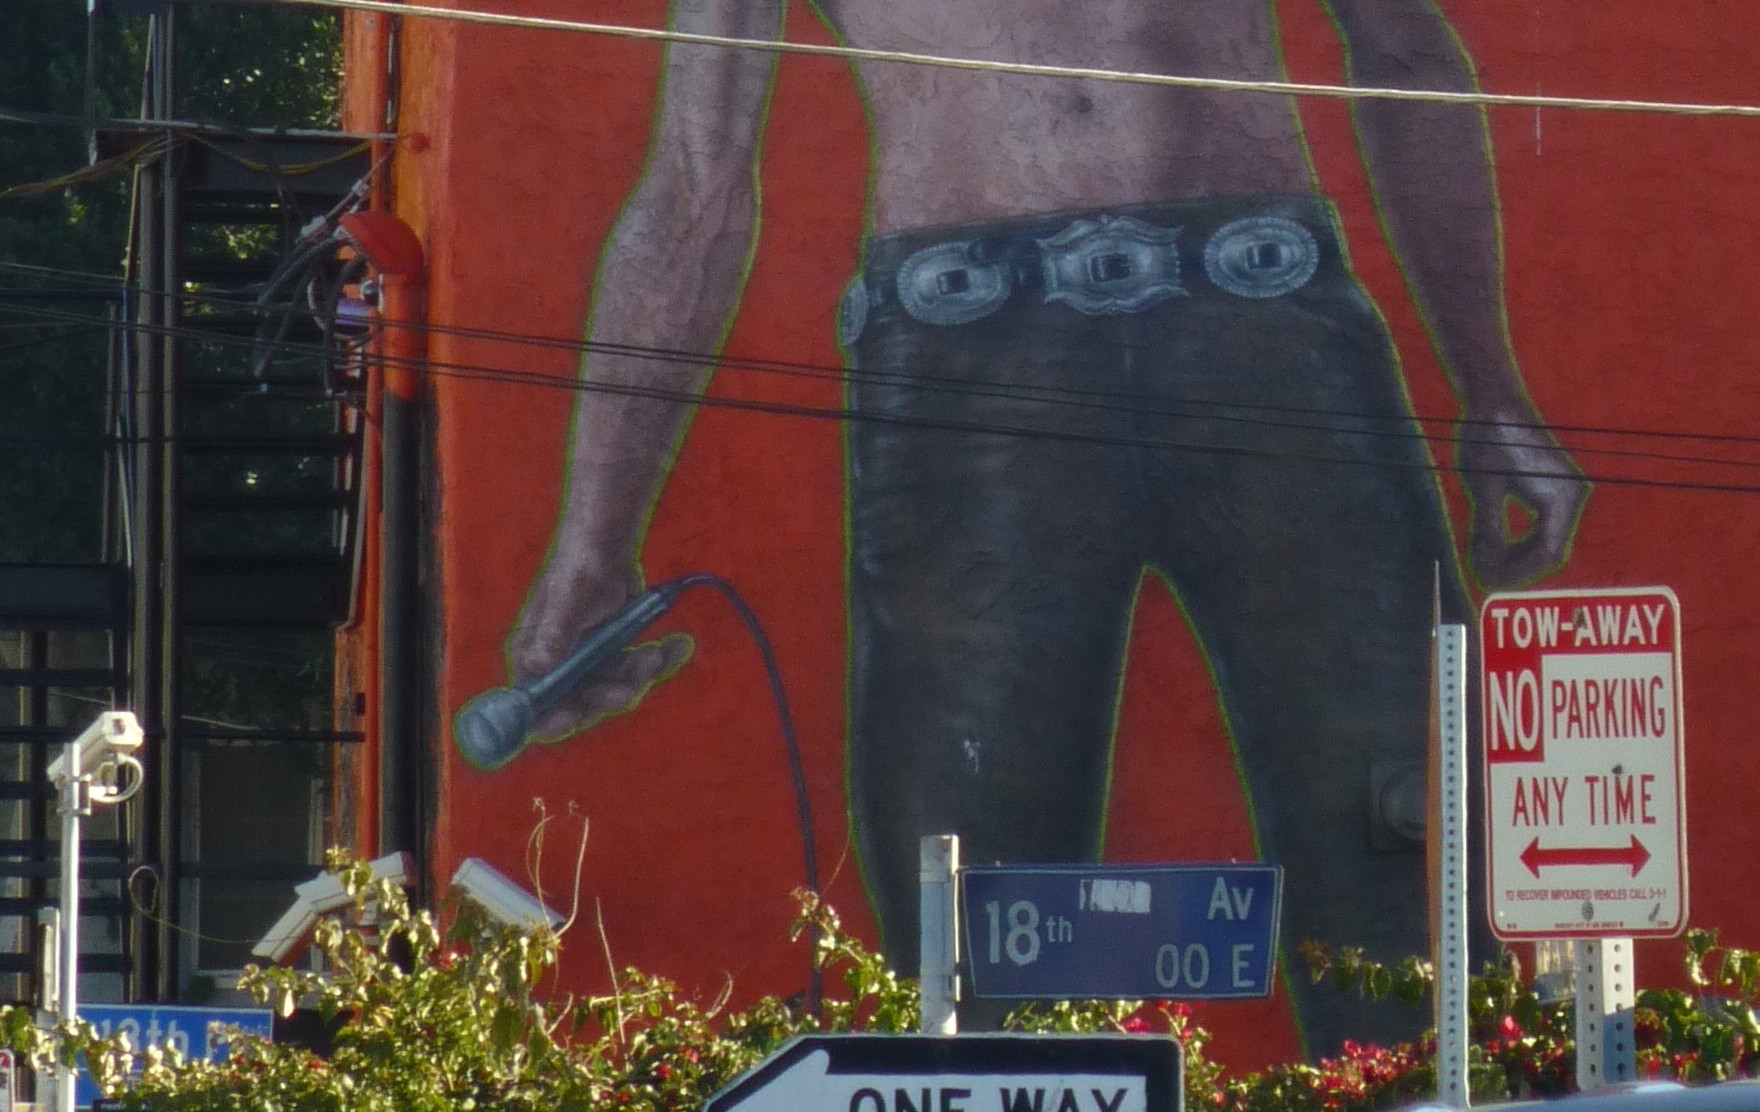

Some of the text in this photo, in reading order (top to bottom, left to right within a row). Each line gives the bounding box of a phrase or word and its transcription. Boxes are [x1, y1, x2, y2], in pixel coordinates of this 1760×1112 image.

[1491, 604, 1666, 649] TOW-AWAY
[1489, 668, 1666, 752] NO PARKING
[1512, 774, 1656, 826] ANY TIME
[1506, 890, 1515, 901] TO
[1516, 889, 1549, 901] RECOVER
[1551, 889, 1592, 901] IMPOUNDED
[1594, 889, 1628, 900] VEHICLES
[1629, 889, 1647, 900] CALL
[985, 900, 1072, 966] 18th
[1155, 943, 1255, 989] 00 E
